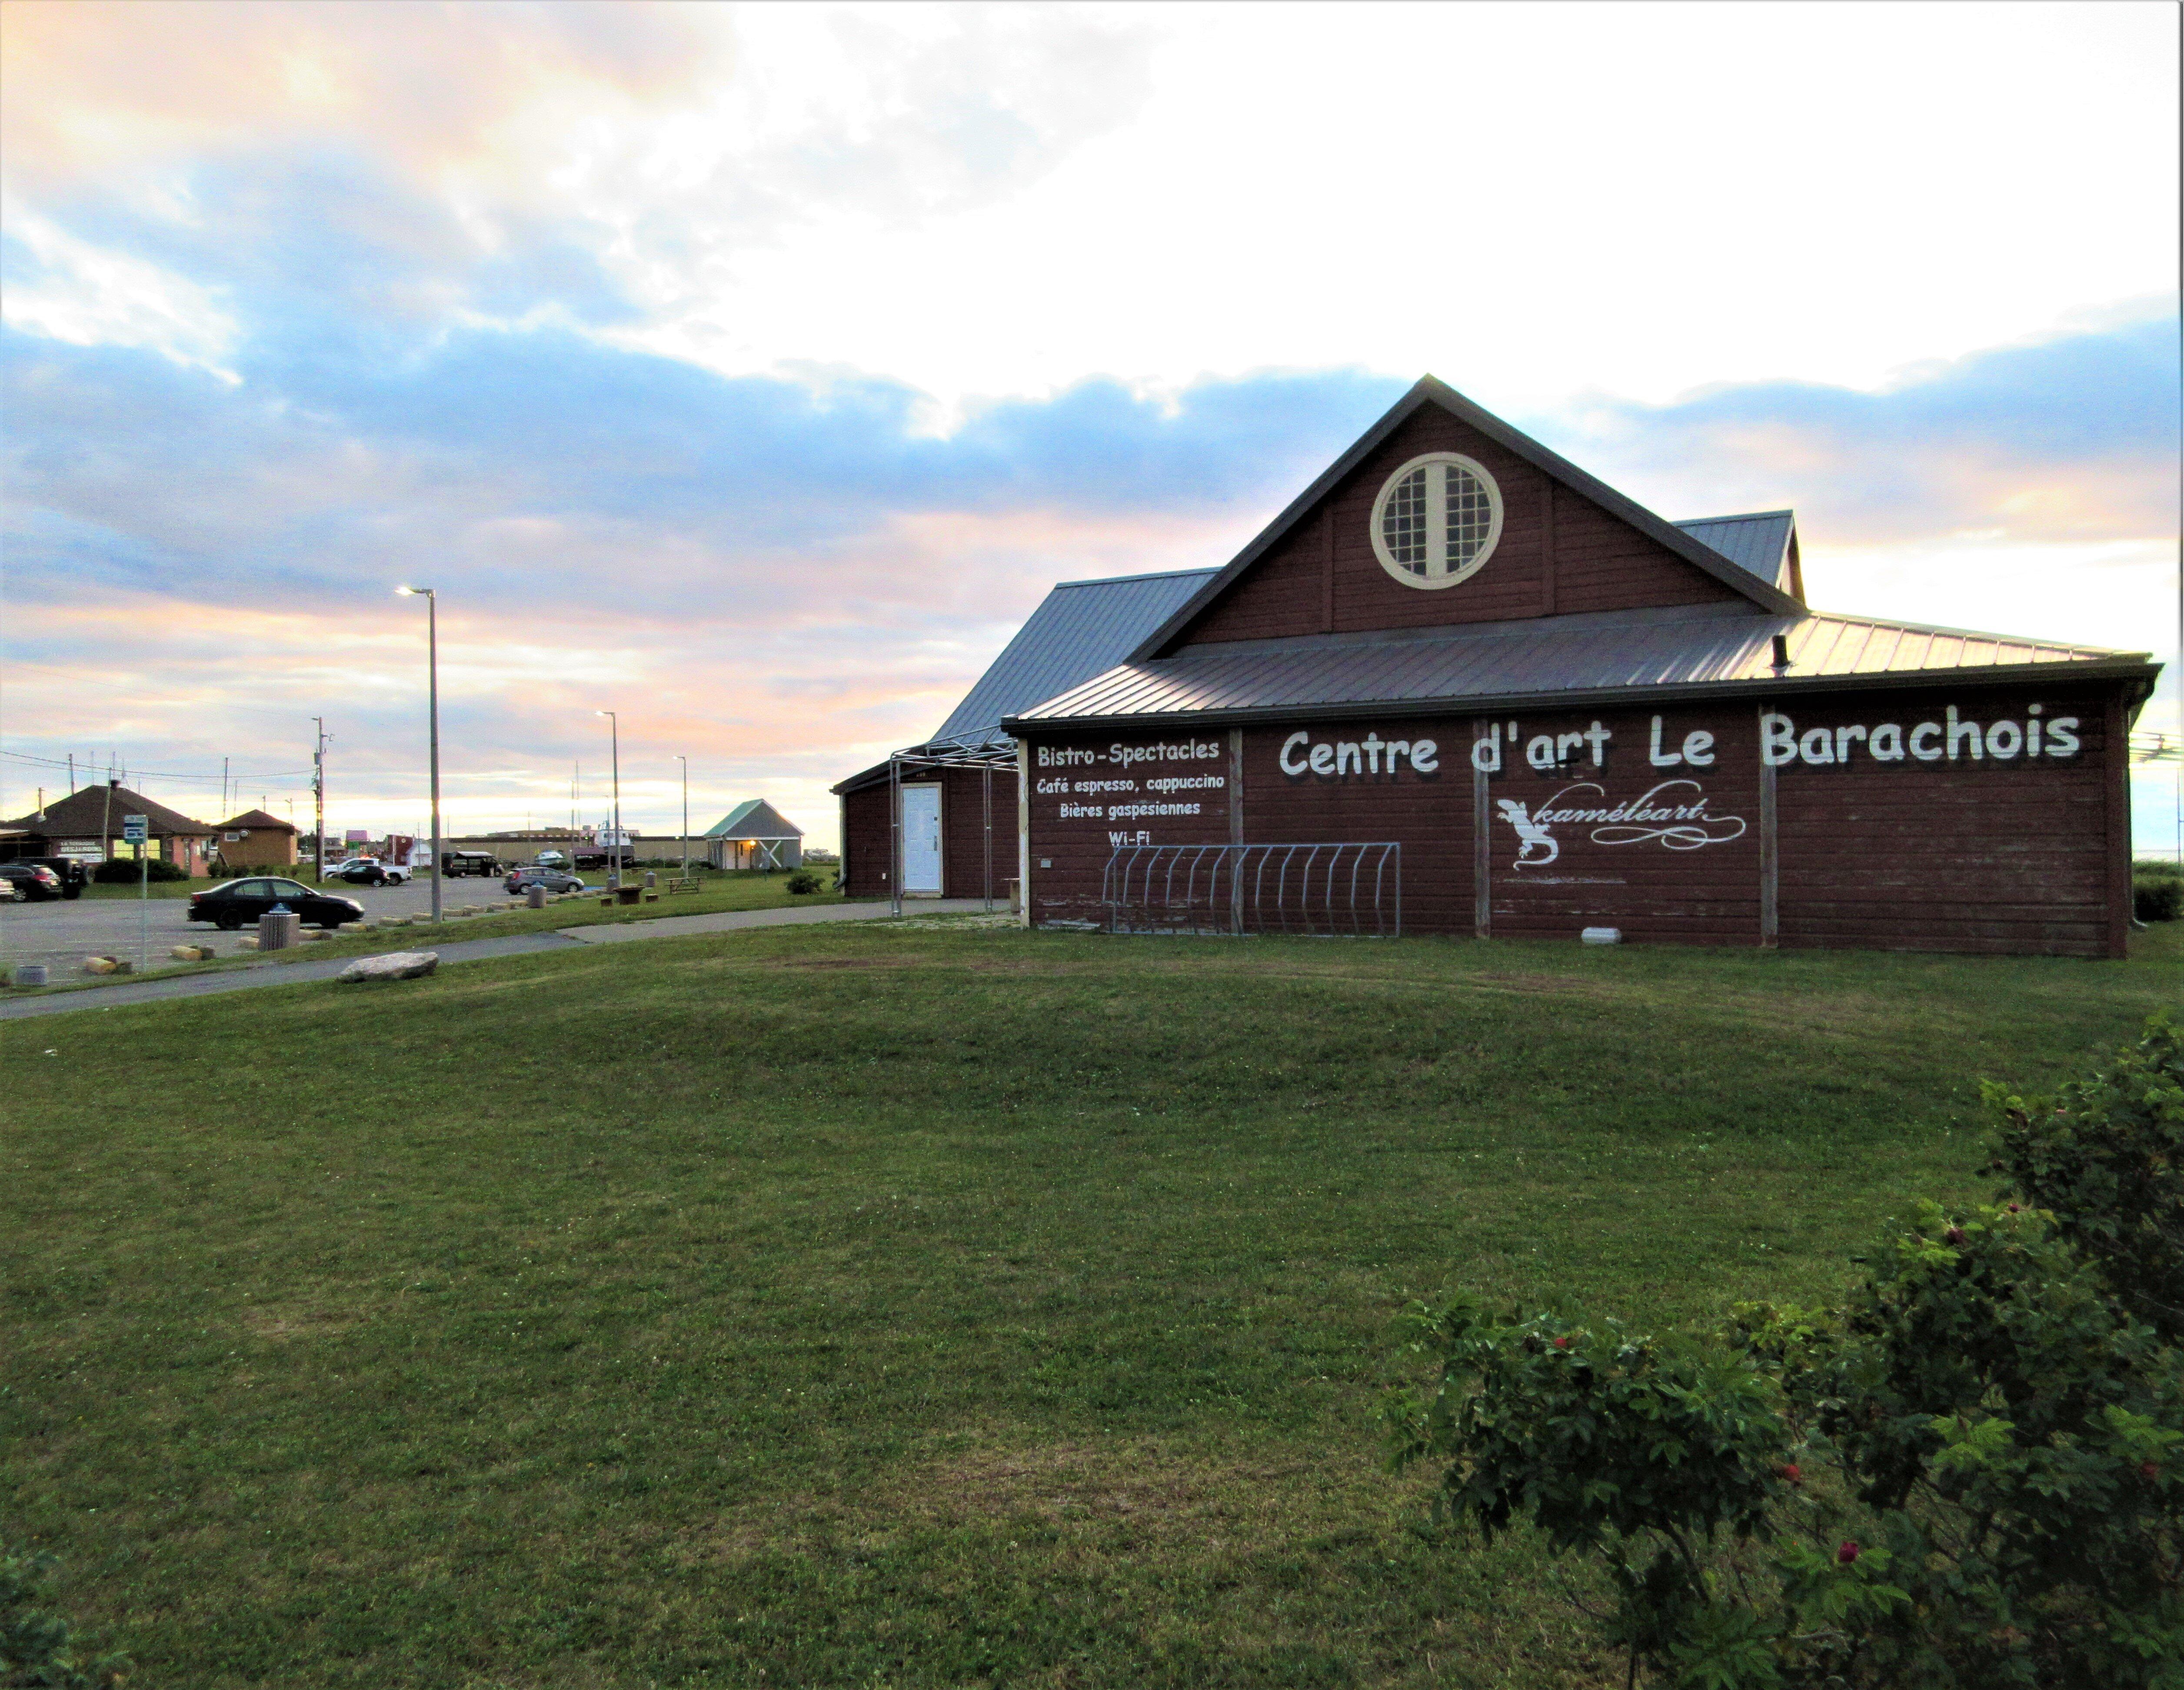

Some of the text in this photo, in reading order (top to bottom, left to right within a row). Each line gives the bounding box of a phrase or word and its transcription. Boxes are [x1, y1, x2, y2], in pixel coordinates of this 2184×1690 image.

[1279, 703, 2079, 775] Centre d'art Le Barachois
[1037, 773, 1225, 796] Café espresso, cappuccino
[1060, 801, 1200, 821] Bières gaspesiennes
[1109, 830, 1150, 846] Wi-Fi
